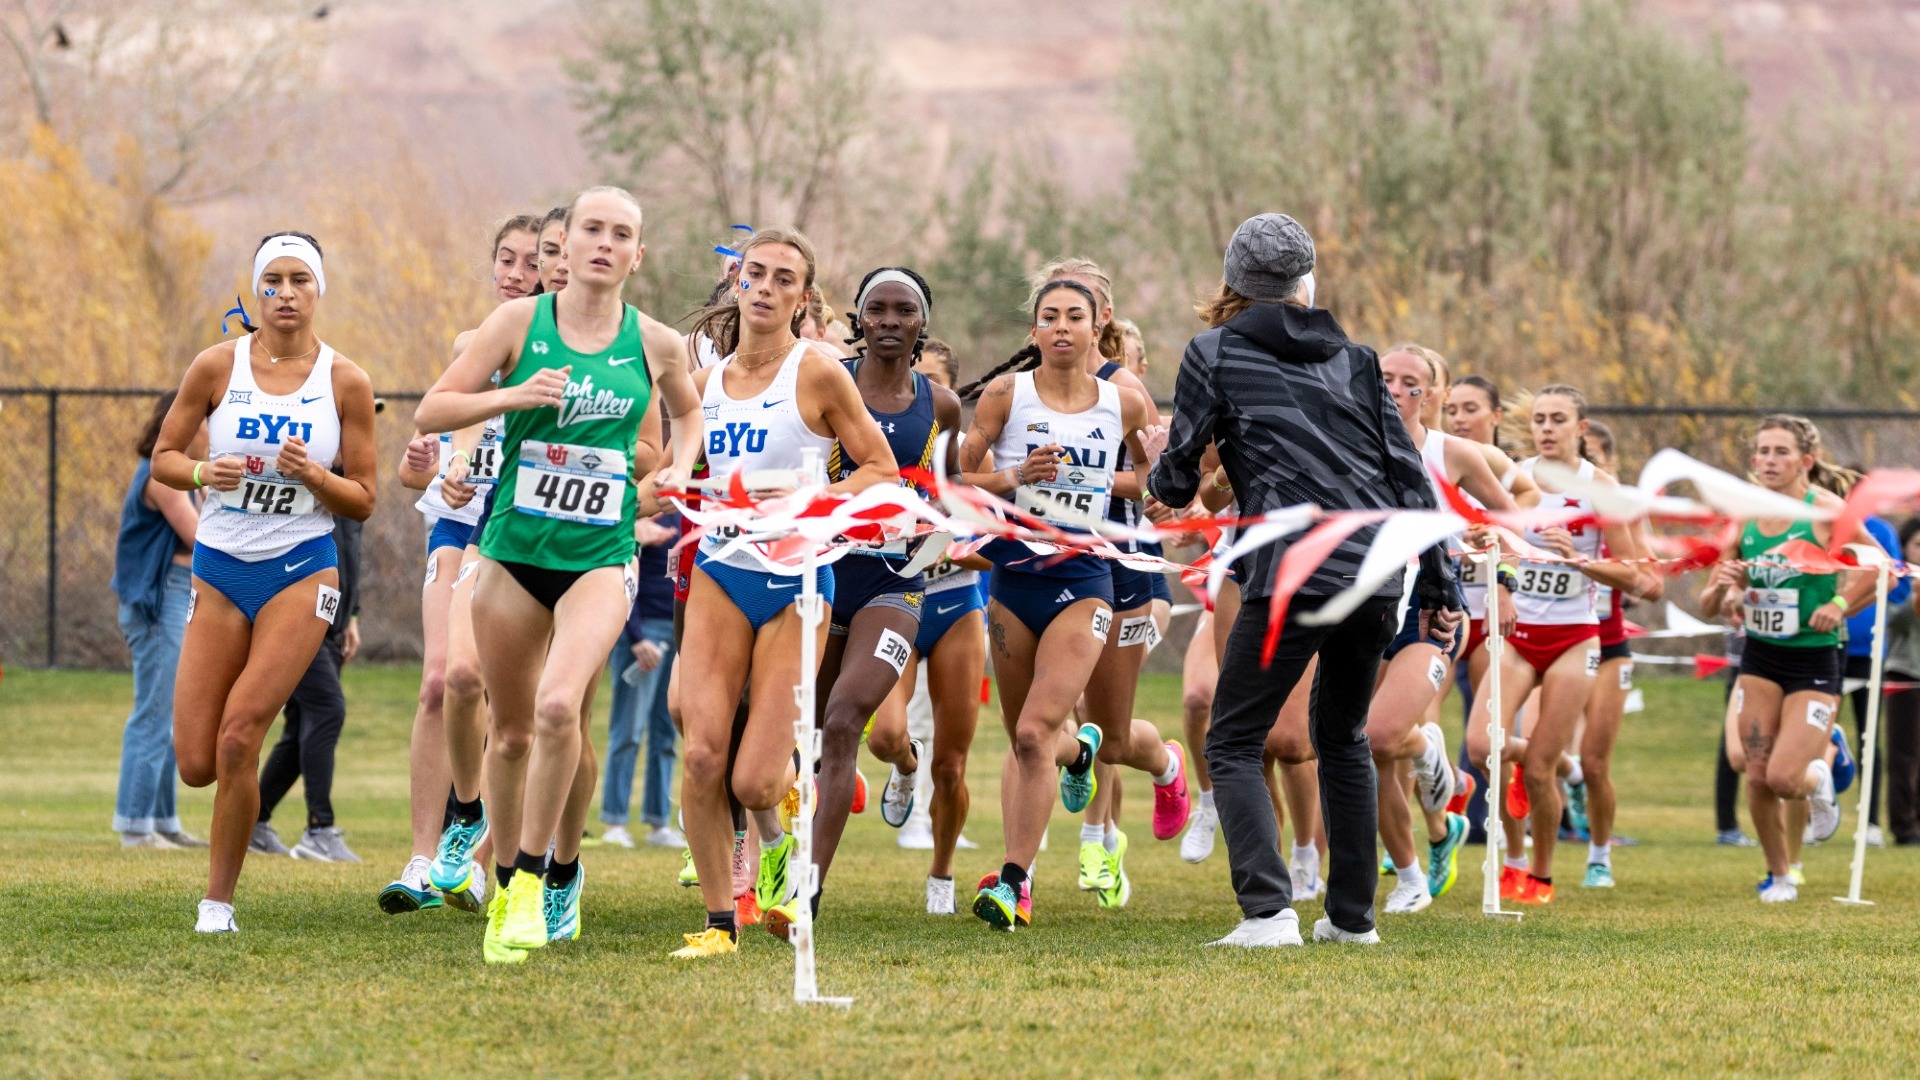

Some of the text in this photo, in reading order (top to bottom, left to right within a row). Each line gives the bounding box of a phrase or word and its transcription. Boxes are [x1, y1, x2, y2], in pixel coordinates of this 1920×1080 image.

[557, 389, 635, 429] Valley
[236, 413, 313, 444] BYU
[709, 422, 768, 457] BYU
[241, 482, 296, 514] 142
[535, 474, 610, 515] 408
[1521, 570, 1570, 595] 358
[321, 593, 337, 616] 142
[1121, 621, 1147, 641] 377
[1752, 609, 1784, 632] 412
[881, 637, 908, 667] 318
